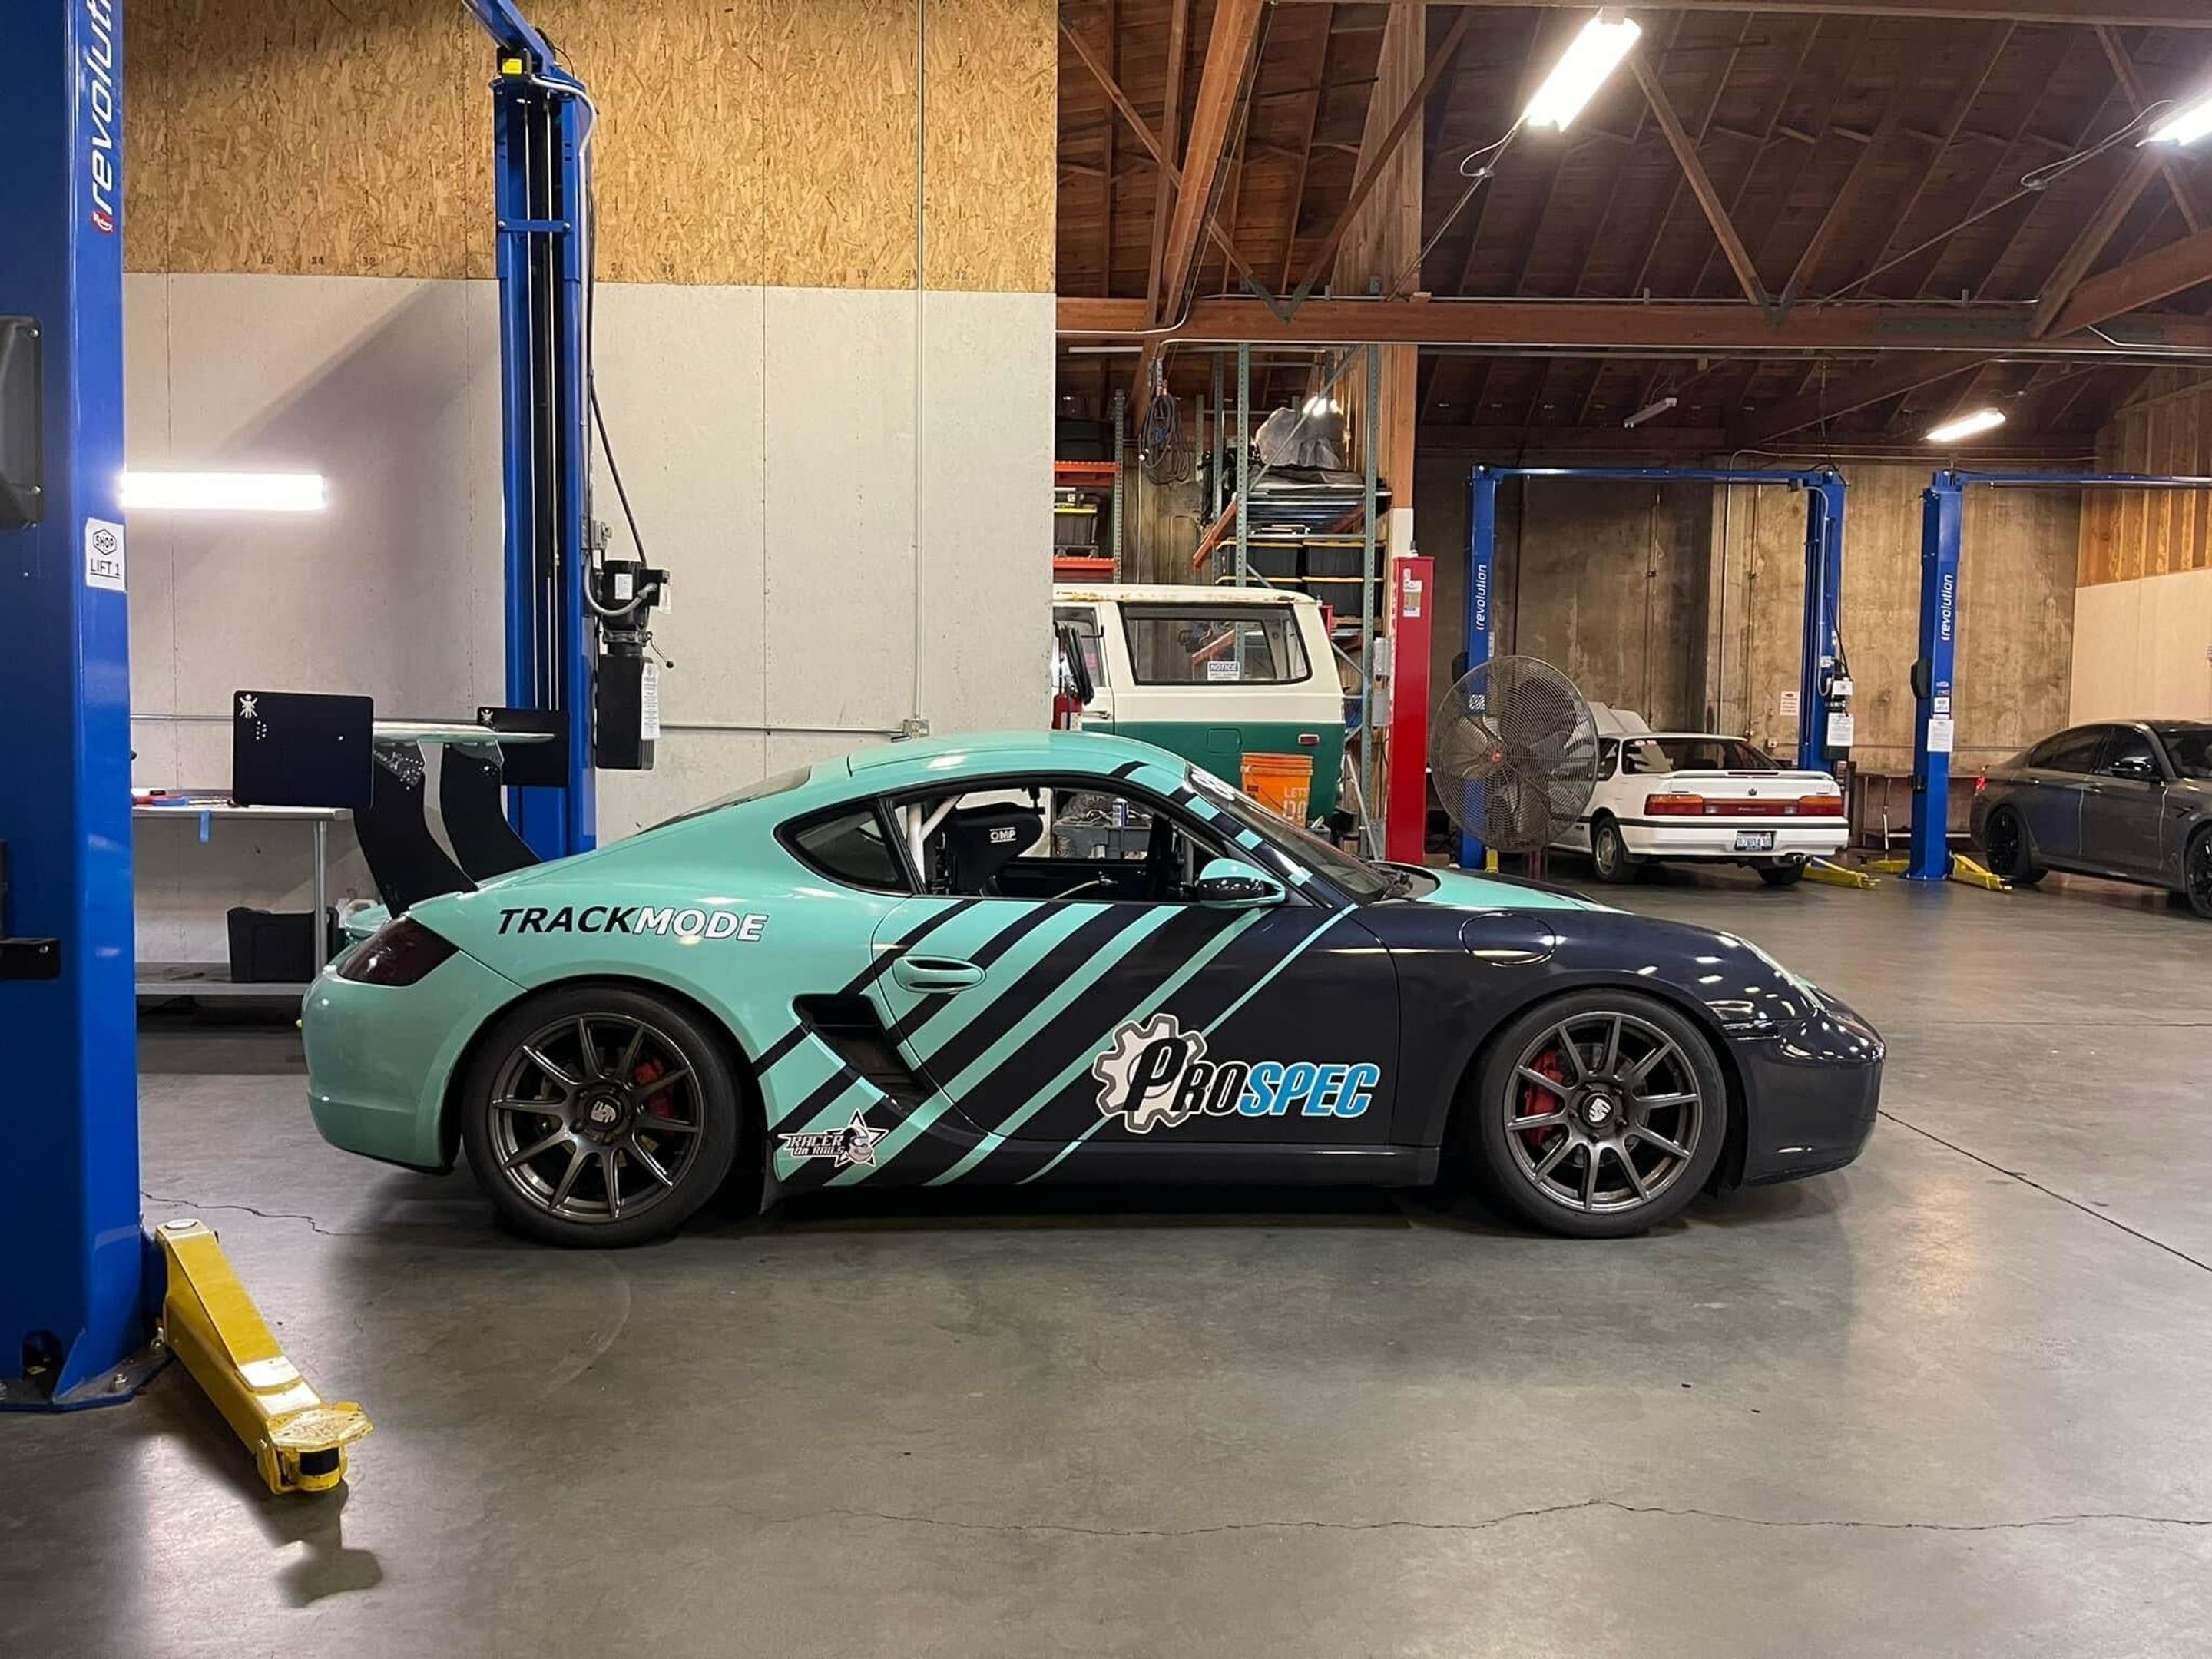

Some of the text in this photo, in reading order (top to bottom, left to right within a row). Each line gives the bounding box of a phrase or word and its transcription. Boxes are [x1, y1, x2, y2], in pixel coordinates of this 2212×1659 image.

[91, 558, 120, 576] LIFT 1
[1476, 564, 1487, 628] revolution
[1941, 574, 1953, 637] revolution
[990, 830, 1016, 840] OMP
[498, 906, 769, 942] TRACKMODE
[1121, 1037, 1381, 1118] PROSPEC
[790, 1134, 844, 1147] RACER
[812, 1146, 845, 1155] RAILS
